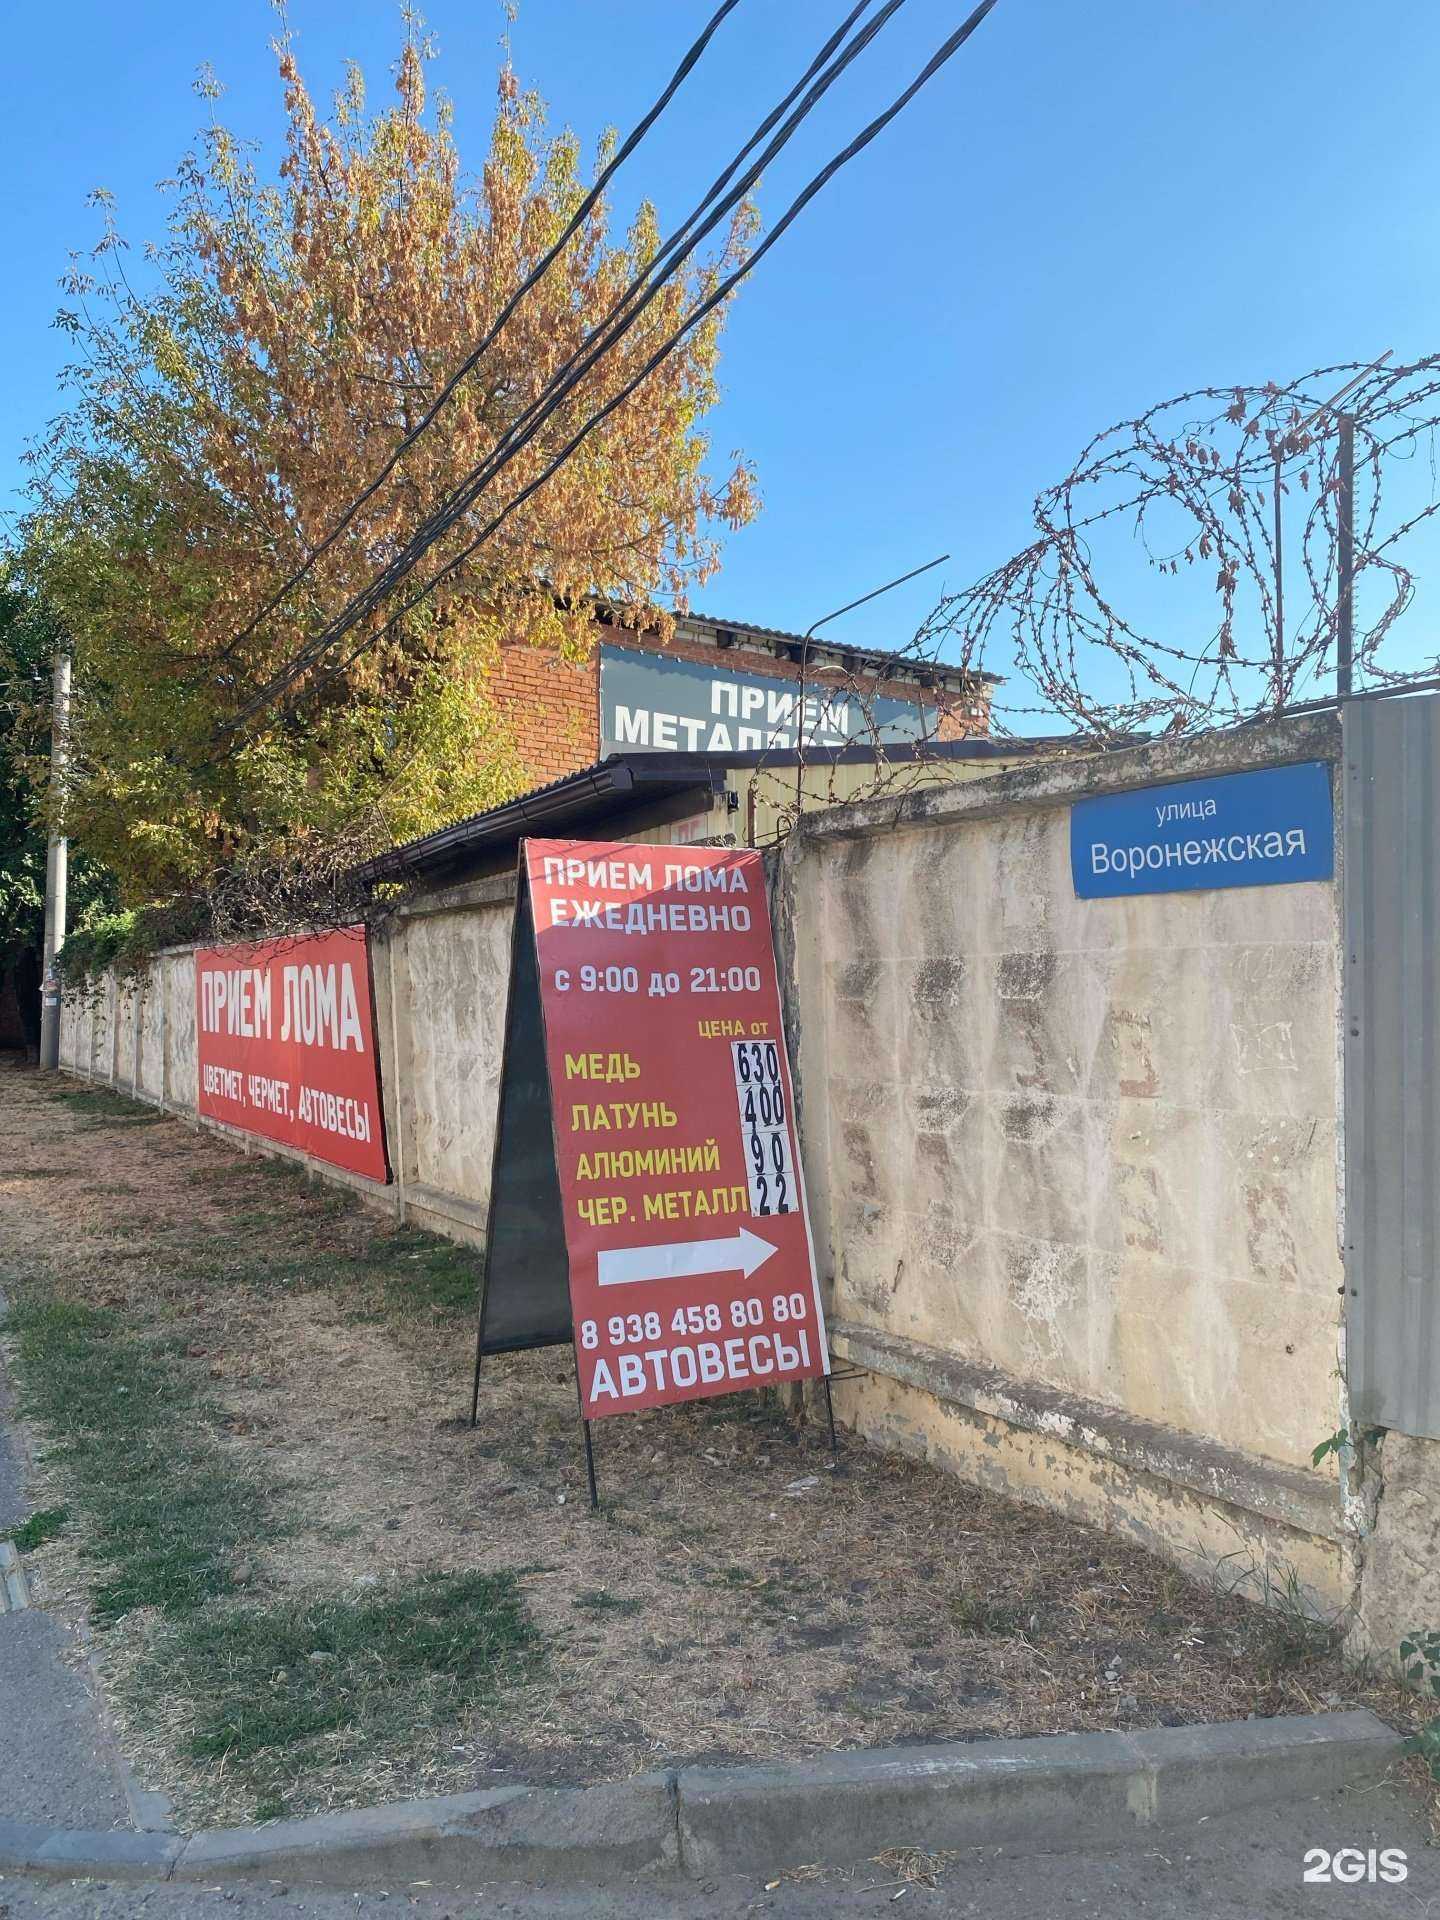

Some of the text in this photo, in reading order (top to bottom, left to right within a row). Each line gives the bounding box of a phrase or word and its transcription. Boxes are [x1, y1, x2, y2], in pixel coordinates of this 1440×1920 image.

[711, 680, 850, 735] ПРИЕМ
[1155, 798, 1217, 828] улица
[1091, 829, 1307, 879] Воронежская
[543, 856, 749, 893] ПРИЕМ ЛОМА
[550, 898, 752, 935] ЕЖЕДНЕВНО
[580, 965, 639, 993] 9:00
[648, 972, 681, 997] до
[690, 966, 761, 993] 21:00
[201, 962, 365, 1053] ПРИЕМ ЛОМА
[698, 1020, 769, 1038] ЦЕНА от
[564, 1053, 641, 1083] МЕДЬ
[737, 1043, 779, 1083] 630
[203, 1063, 371, 1143] ЦВЕТМЕТ, ЧЕРМЕТ, АВТОВЕСЫ
[571, 1101, 678, 1132] ЛАТУНЬ
[744, 1086, 785, 1128] 400
[575, 1137, 721, 1180] АЛЮМИНИЙ
[750, 1134, 784, 1174] 90
[577, 1186, 748, 1226] ЧЕР. МЕТАЛЛ
[756, 1174, 789, 1216] 22
[581, 1293, 806, 1349] 8 938 458 80 80
[589, 1329, 811, 1402] АВТОВЕСЫ
